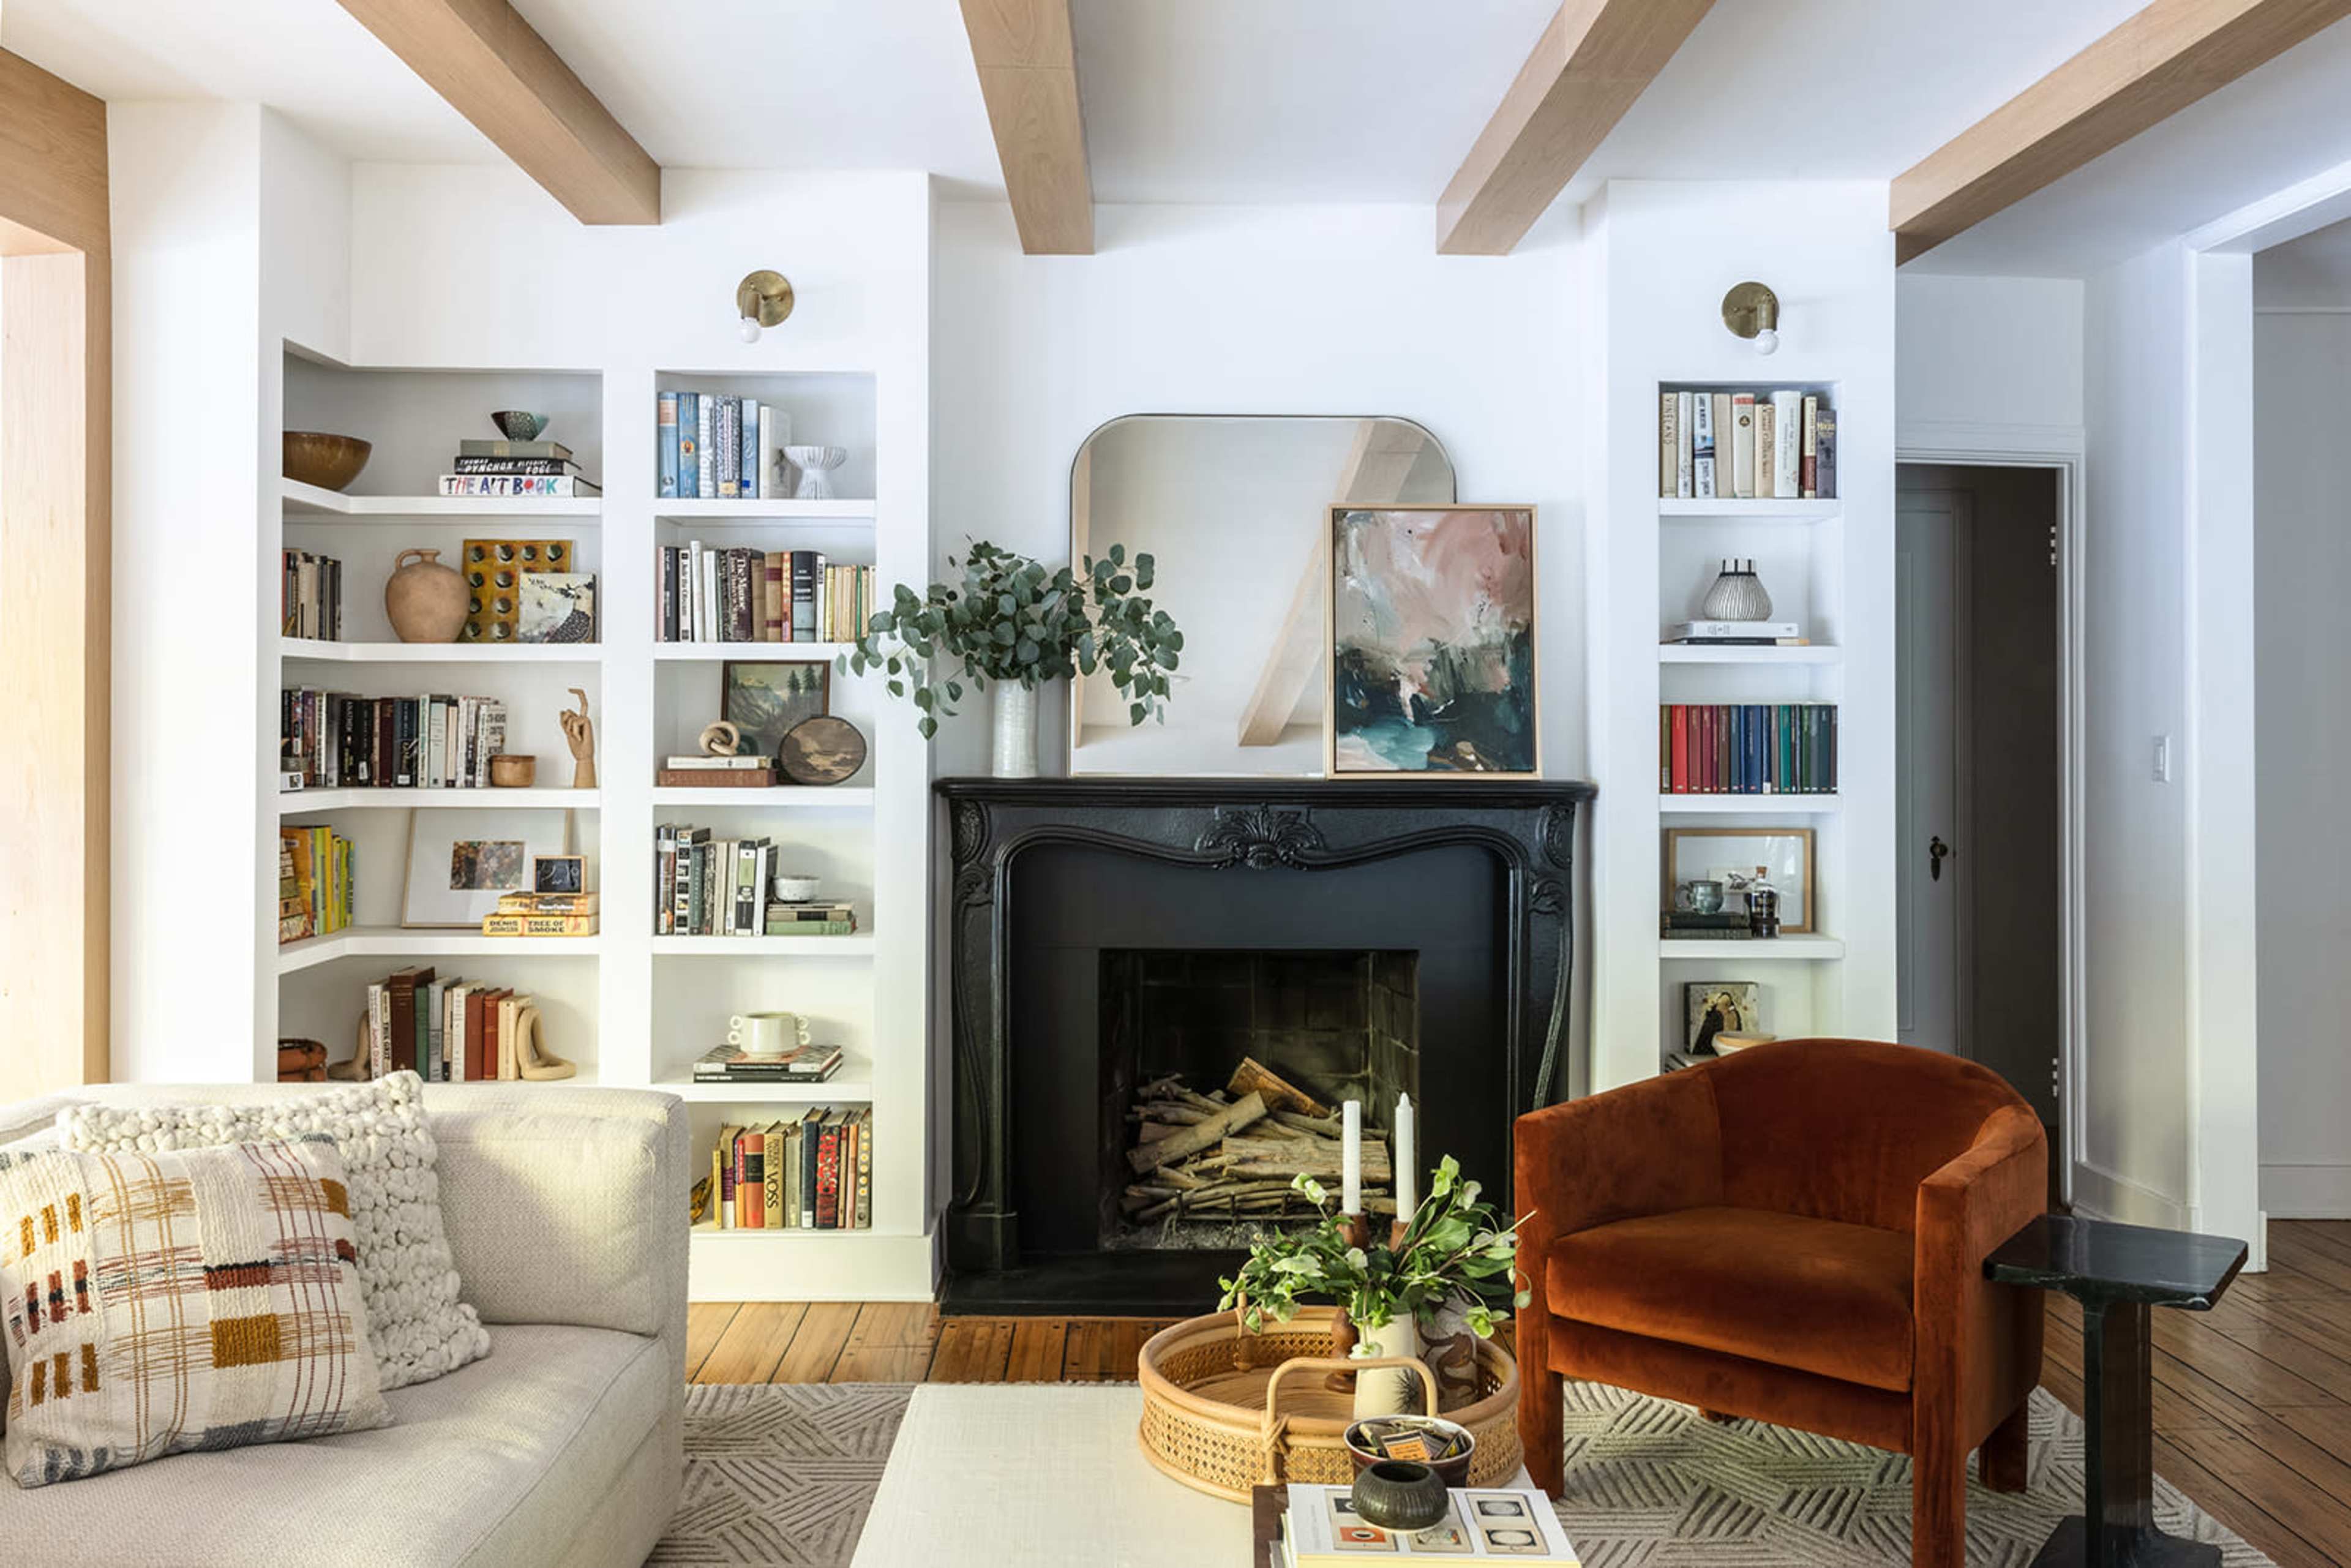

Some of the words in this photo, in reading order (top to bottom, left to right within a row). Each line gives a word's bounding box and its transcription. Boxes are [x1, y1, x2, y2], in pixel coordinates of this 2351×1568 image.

[465, 462, 514, 473] PYNCHON
[445, 477, 475, 495] THE
[512, 477, 560, 495] BOOK
[765, 1171, 779, 1209] VOSS
